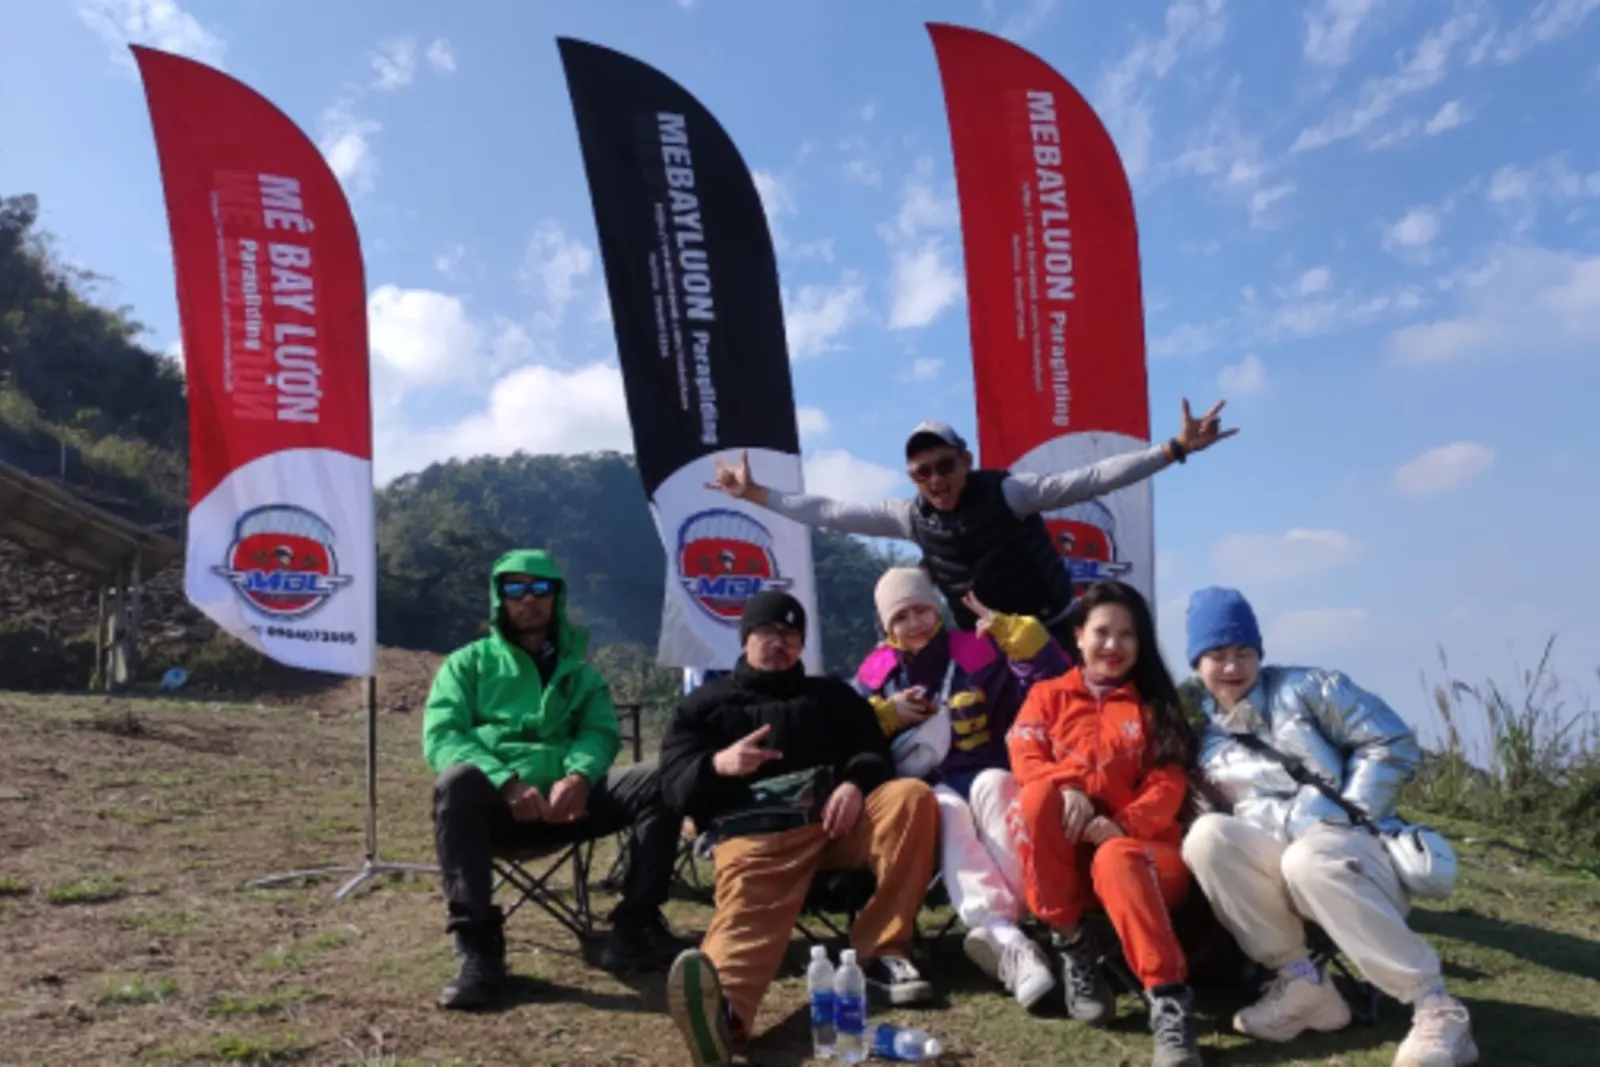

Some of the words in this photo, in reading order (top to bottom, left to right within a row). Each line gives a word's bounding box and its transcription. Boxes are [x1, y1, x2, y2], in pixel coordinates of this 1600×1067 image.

[257, 173, 314, 233] MÊ
[1026, 90, 1074, 301] MEBAYLUON
[239, 238, 262, 350] Paragliding
[267, 242, 315, 315] BAY
[656, 112, 714, 320] MEBAYLUON
[693, 330, 717, 445] Paragliding
[266, 323, 322, 423] LƯỢN
[1049, 311, 1070, 426] Paragliding
